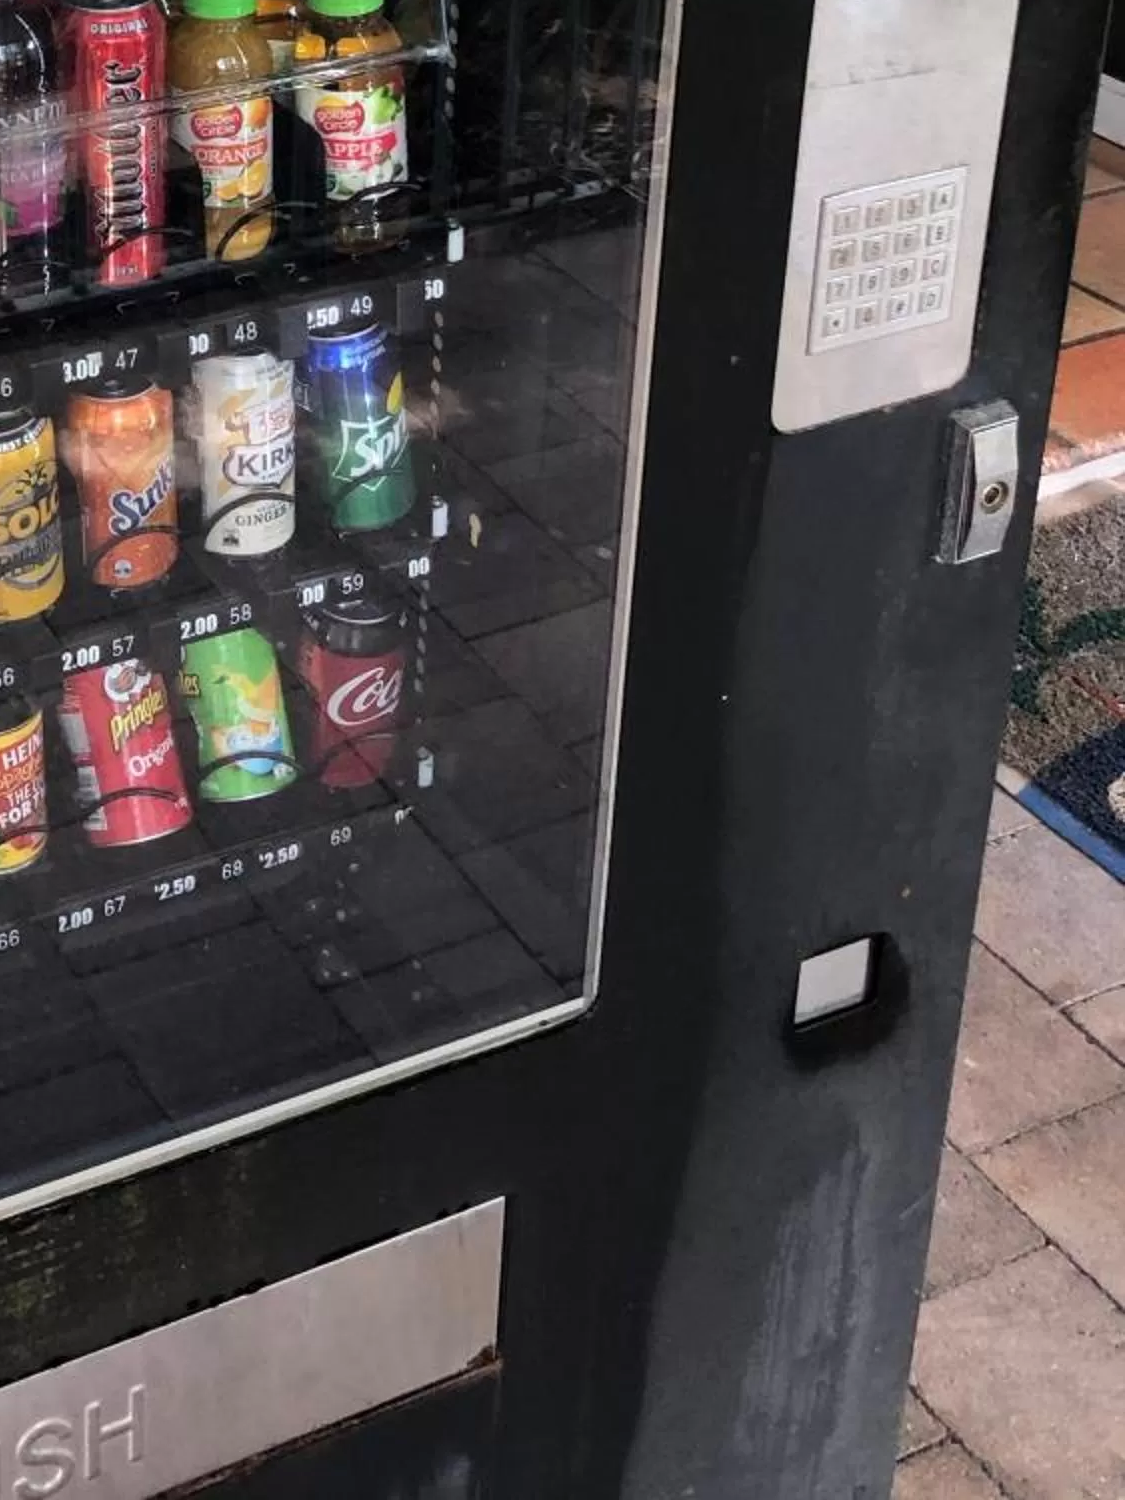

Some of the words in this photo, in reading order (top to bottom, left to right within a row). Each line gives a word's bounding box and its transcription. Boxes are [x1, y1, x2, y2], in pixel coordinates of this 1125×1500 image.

[350, 295, 373, 317] 49
[234, 321, 258, 343] 48
[115, 348, 138, 370] 47
[341, 573, 364, 595] 59
[230, 603, 253, 626] 58
[180, 613, 218, 640] 2.00
[112, 635, 136, 658] 57
[61, 645, 101, 672] 2.00
[329, 826, 353, 847] 69
[221, 859, 244, 881] 68
[104, 895, 127, 917] 67
[57, 907, 94, 934] 2.00
